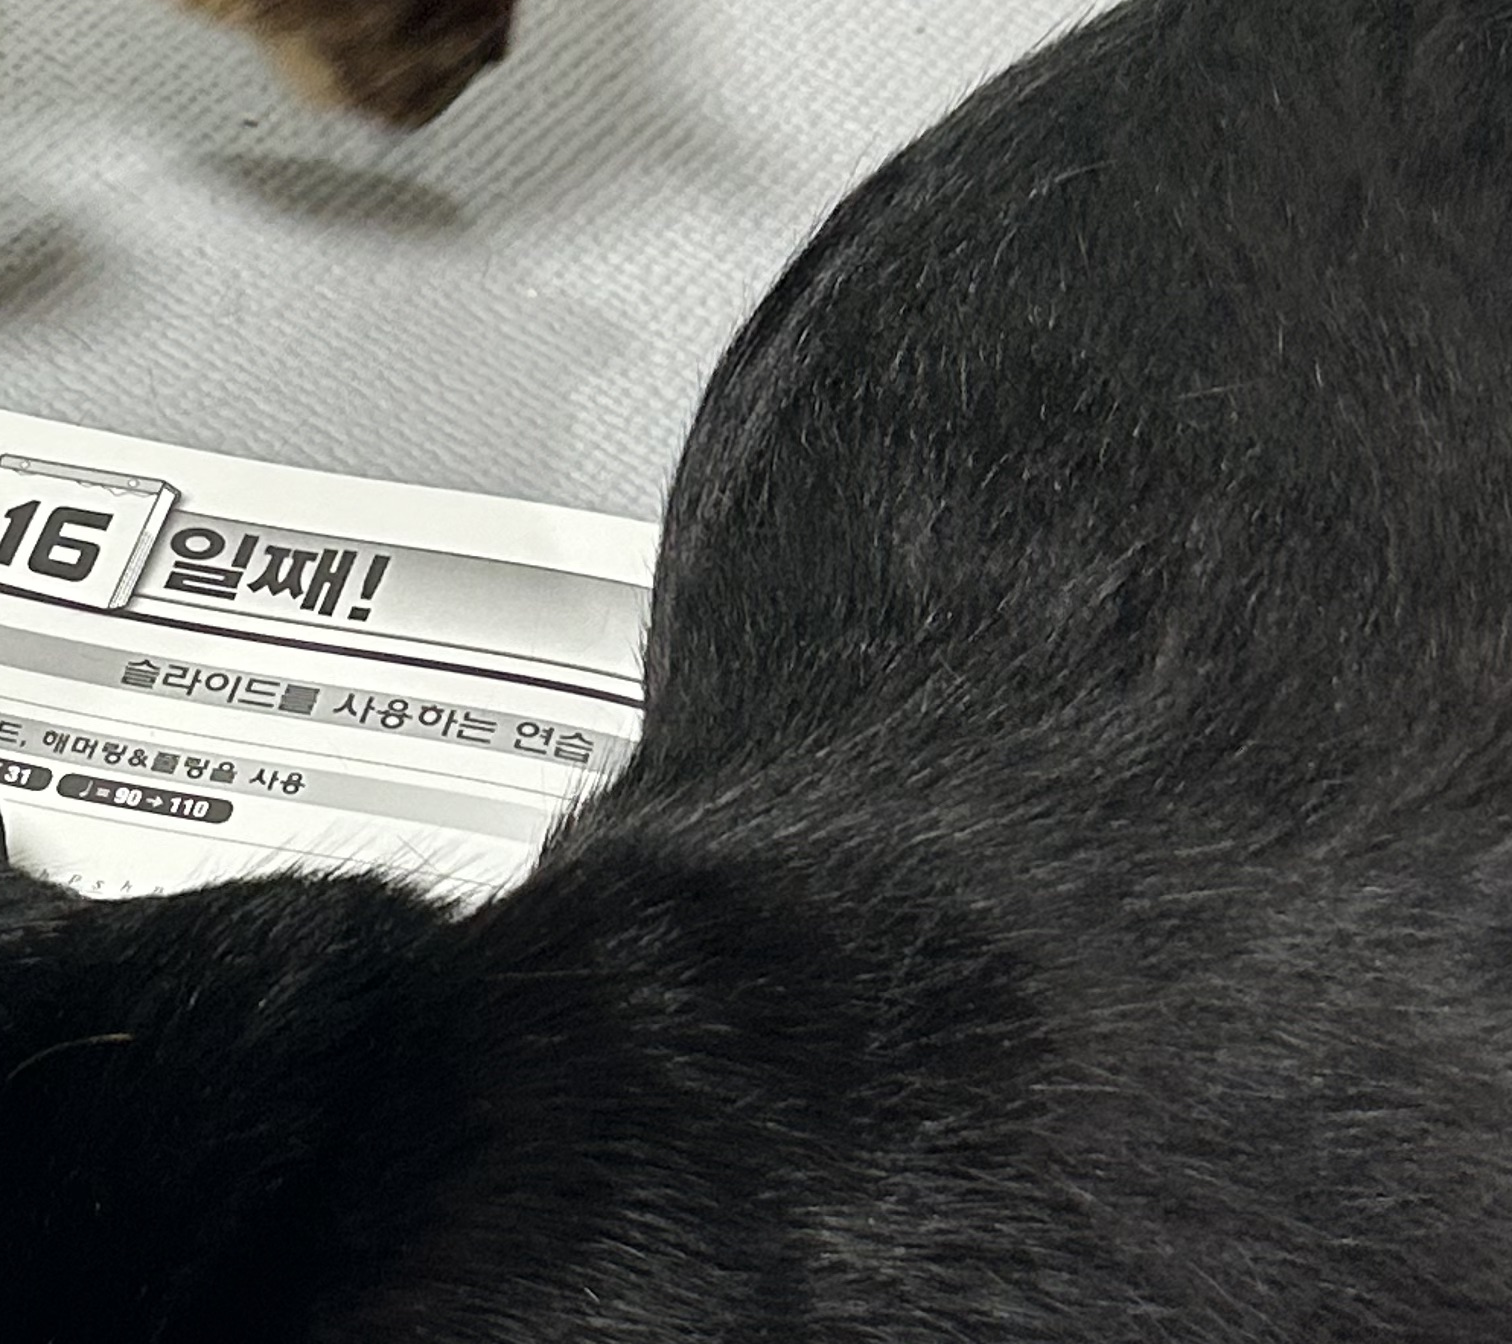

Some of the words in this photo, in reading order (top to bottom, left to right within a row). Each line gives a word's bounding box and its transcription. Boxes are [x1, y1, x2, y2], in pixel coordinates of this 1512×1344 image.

[162, 526, 393, 622] 일째!
[120, 659, 321, 718] 슬라이드를
[333, 693, 498, 745] 사용하는
[513, 718, 595, 765] 연습
[3, 762, 33, 787] 31
[42, 729, 239, 785] 해머링&풀링을
[249, 767, 307, 796] 사용
[113, 786, 144, 807] 90
[169, 796, 211, 819] 110
